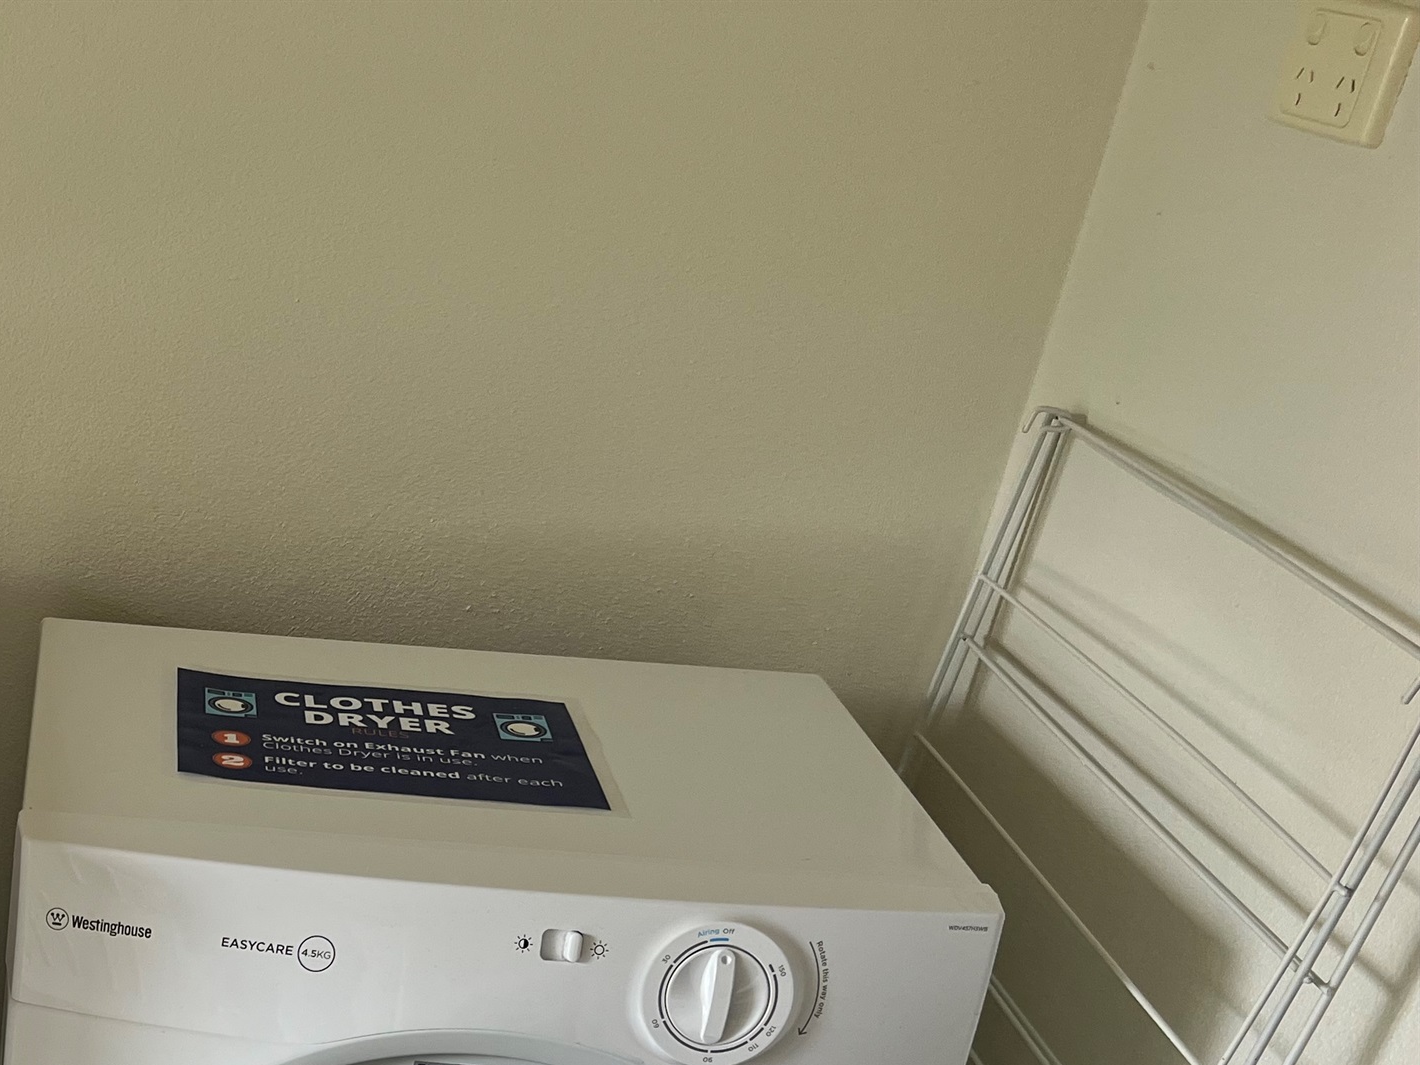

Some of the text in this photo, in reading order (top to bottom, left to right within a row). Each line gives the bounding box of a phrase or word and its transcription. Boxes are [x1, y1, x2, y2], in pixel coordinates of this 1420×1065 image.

[274, 692, 477, 720] CLOTHES
[304, 710, 456, 735] DRYER
[223, 732, 241, 744] 1
[351, 727, 410, 739] RULES
[262, 734, 543, 764] Switch on Exhaust Fan when
[262, 742, 478, 767] Clothes Dryer is in use.
[220, 754, 245, 767] 2
[264, 755, 564, 788] Filter to be cleaned after each
[265, 765, 304, 776] use.
[71, 914, 152, 939] Westinghouse
[697, 929, 720, 938] Airing
[221, 936, 332, 961] EASYCARE 4.5KG
[661, 954, 671, 965] 30
[777, 964, 787, 977] 150
[813, 940, 830, 1019] Rotate this way only
[651, 1019, 660, 1029] 60
[765, 1025, 777, 1037] 120
[747, 1042, 759, 1052] 110
